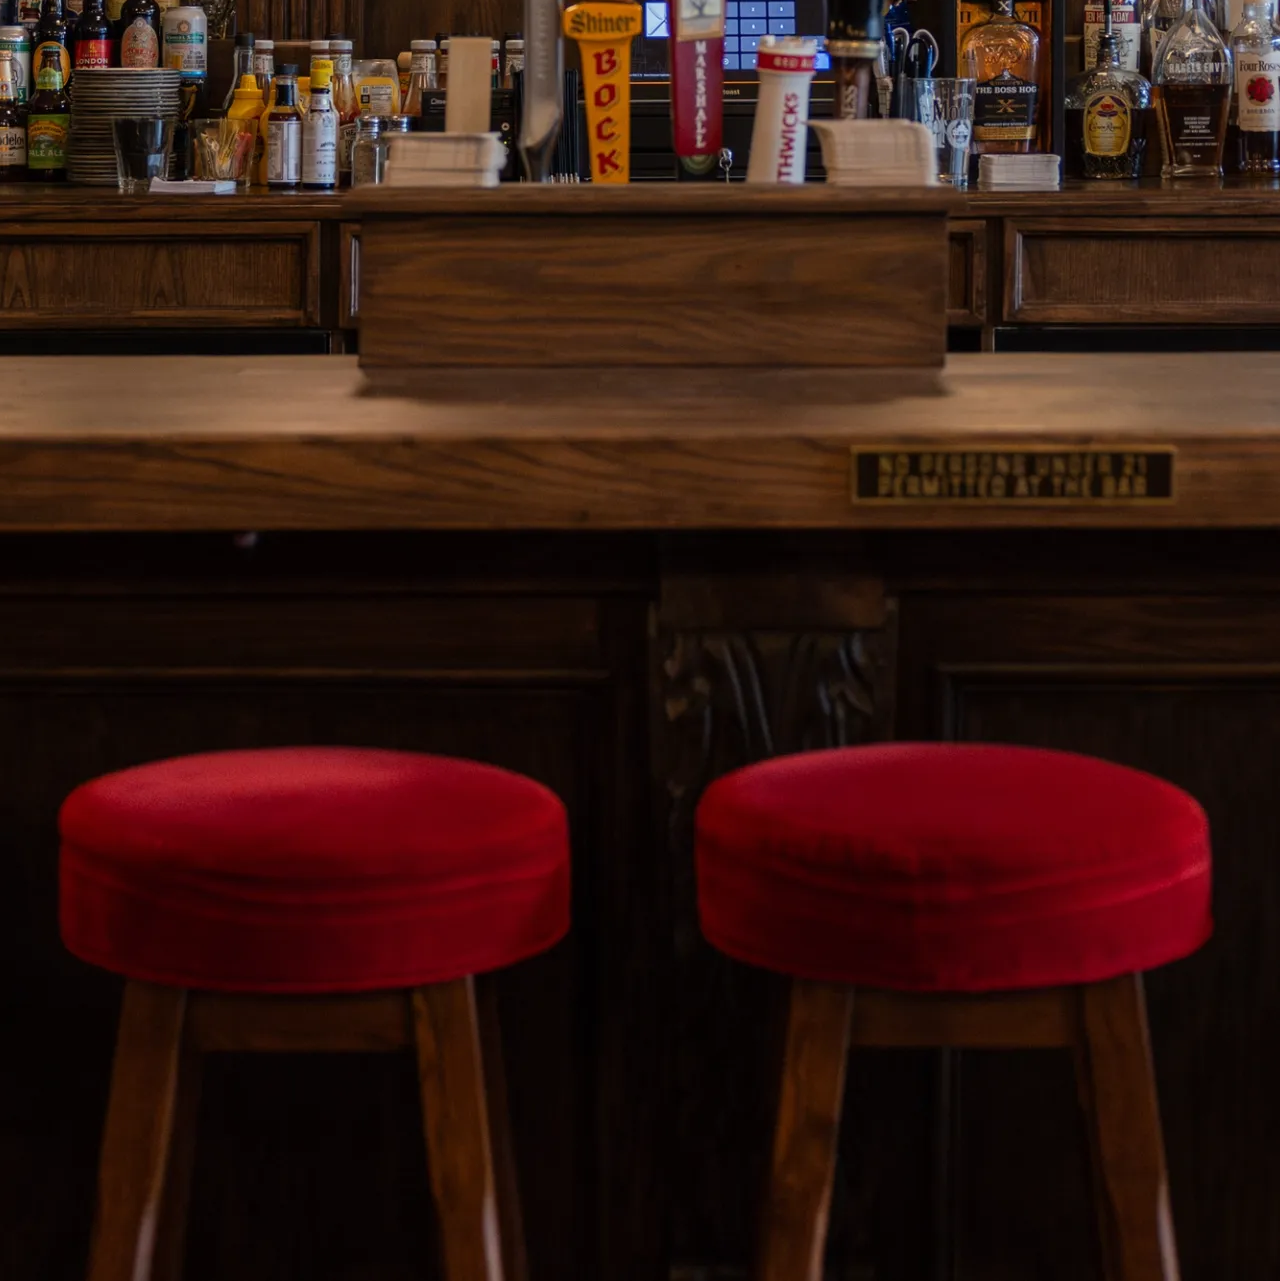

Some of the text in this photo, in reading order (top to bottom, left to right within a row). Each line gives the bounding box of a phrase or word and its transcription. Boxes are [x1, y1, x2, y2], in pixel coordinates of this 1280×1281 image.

[998, 0, 1010, 11] X
[570, 10, 636, 35] Shiner
[1097, 11, 1129, 23] HOADAY
[1239, 60, 1257, 71] Four
[694, 40, 708, 149] MARSHALL
[975, 85, 1038, 94] THE BOSS HOG
[591, 48, 620, 175] BOCK
[996, 99, 1016, 113] X
